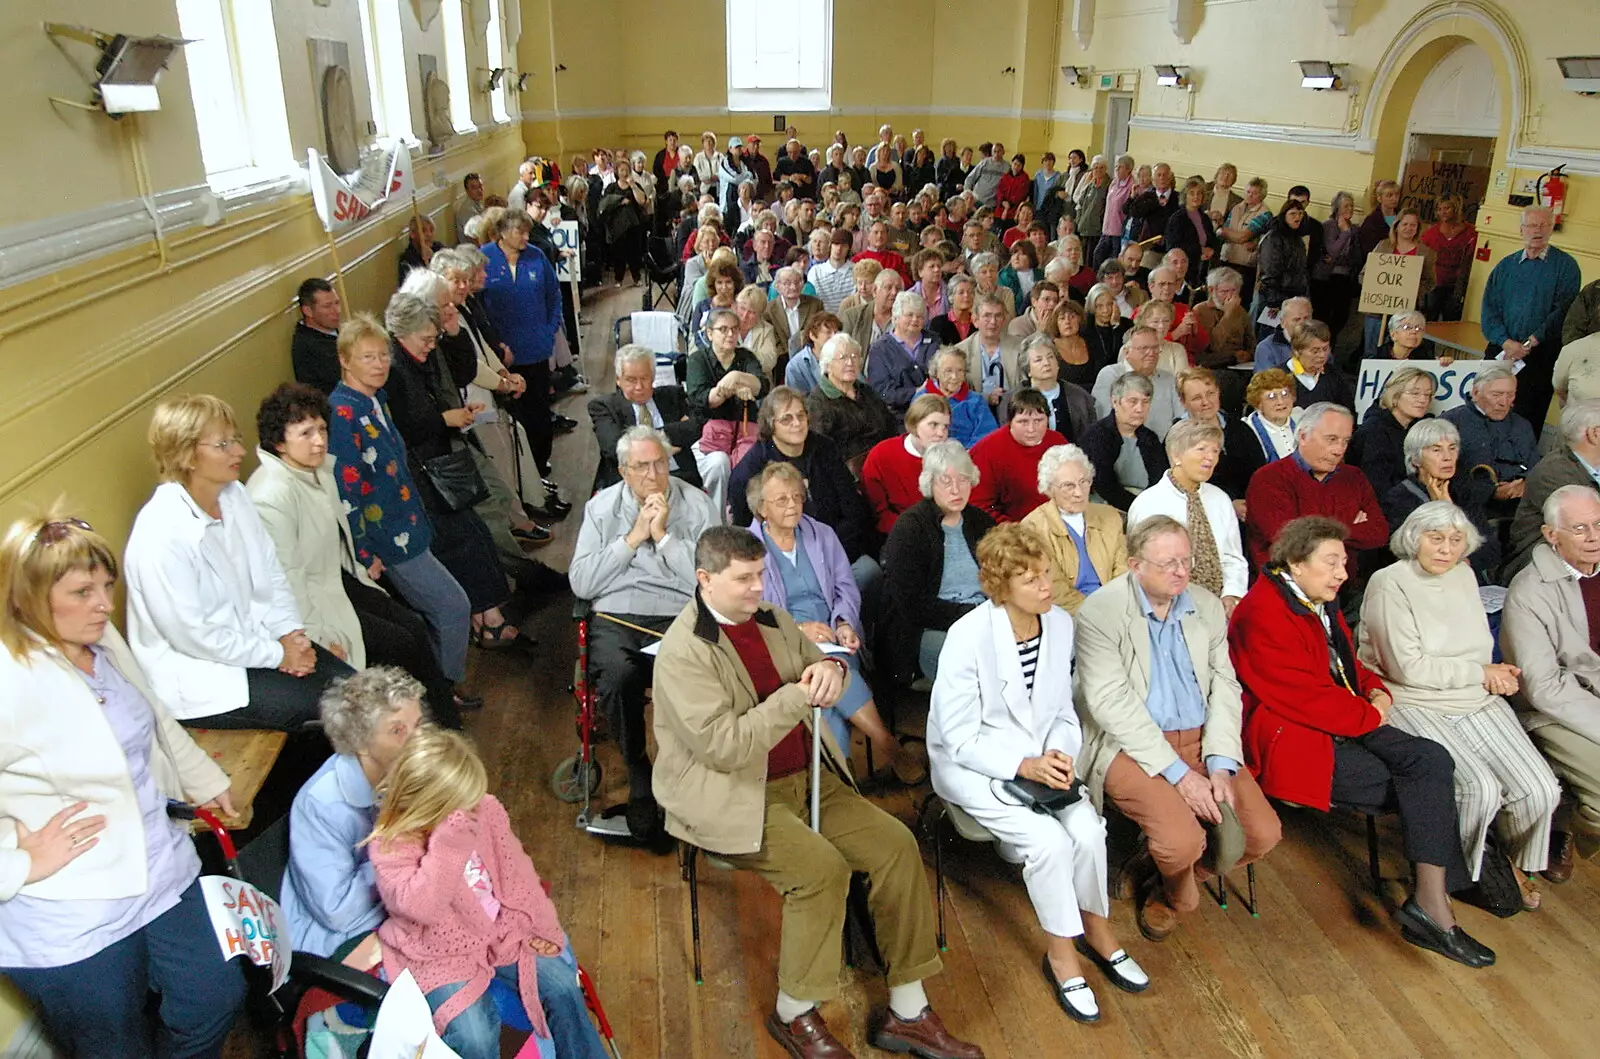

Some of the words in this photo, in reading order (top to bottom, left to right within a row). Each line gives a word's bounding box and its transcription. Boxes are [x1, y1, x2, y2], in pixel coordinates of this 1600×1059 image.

[1432, 161, 1466, 179] WHAT
[1379, 253, 1407, 268] SAVE
[1376, 271, 1403, 287] OUR
